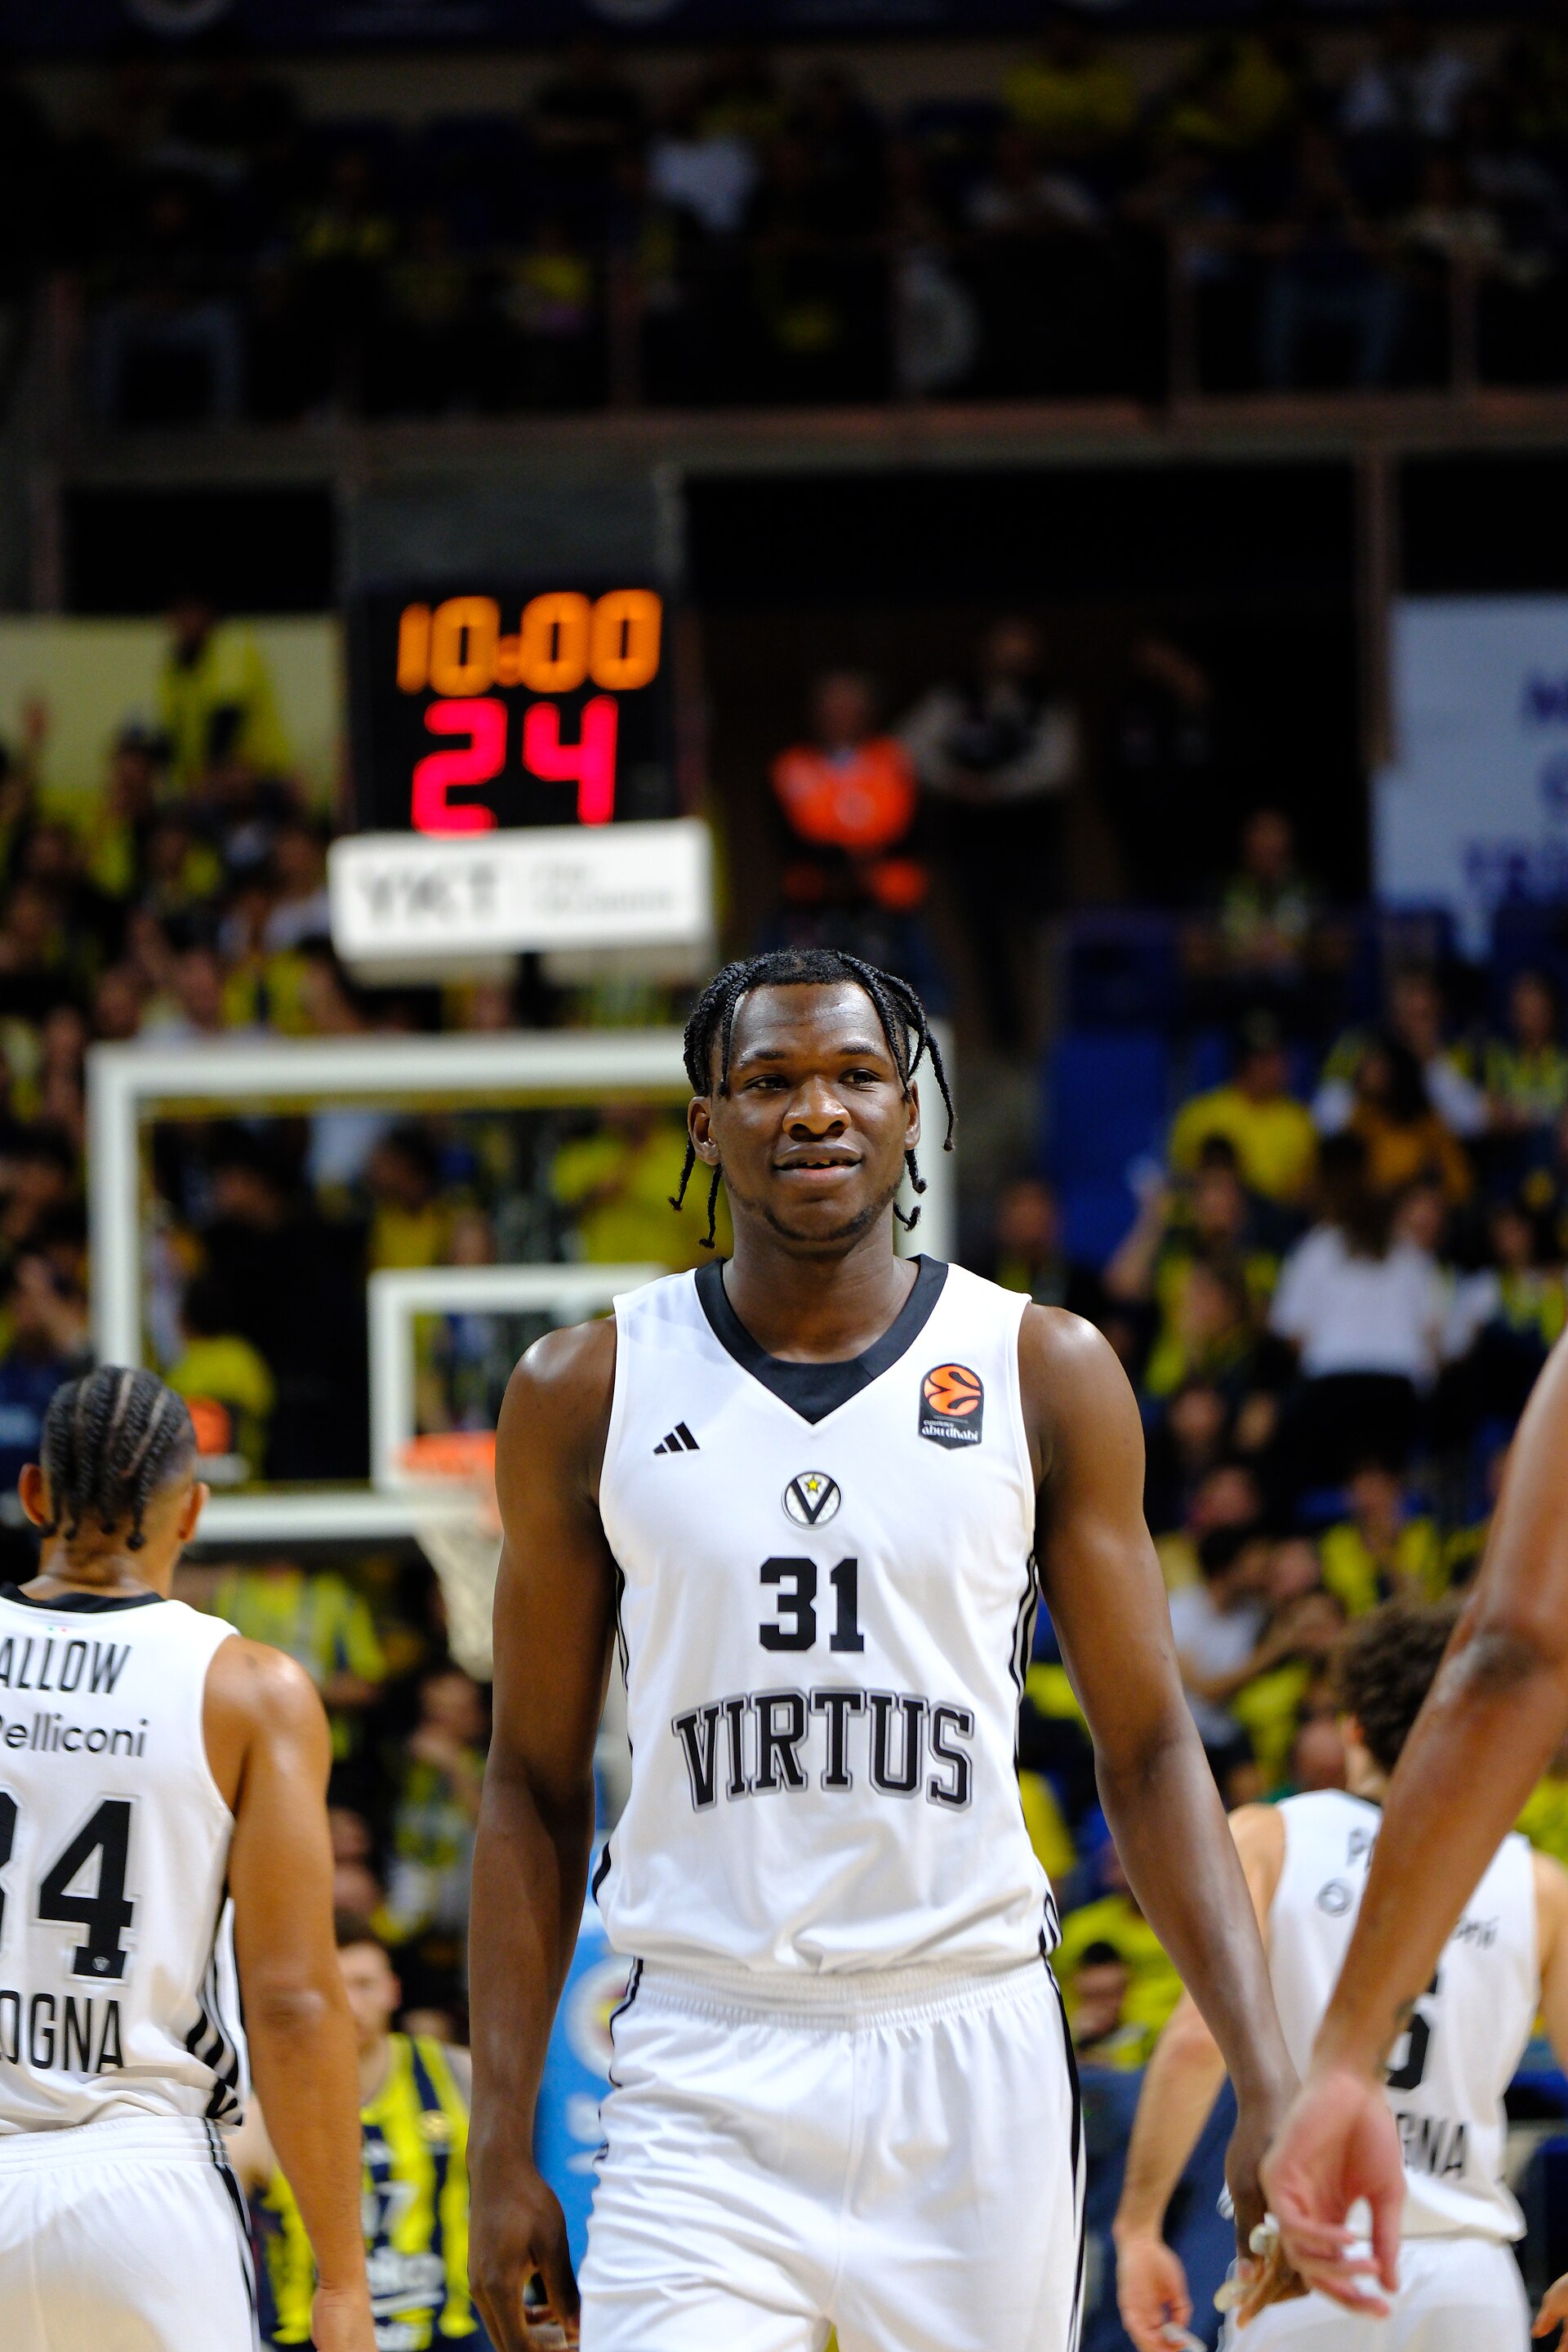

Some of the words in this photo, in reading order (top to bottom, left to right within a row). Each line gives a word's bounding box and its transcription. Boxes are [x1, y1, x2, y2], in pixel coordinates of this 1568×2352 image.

[396, 589, 662, 697] 10:00
[412, 695, 618, 840] 24
[922, 1426, 945, 1437] abu
[946, 1428, 978, 1441] dhabi
[759, 1557, 866, 1652] 31
[0, 1712, 149, 1757] elliconi
[670, 1686, 976, 1813] VIRTUS
